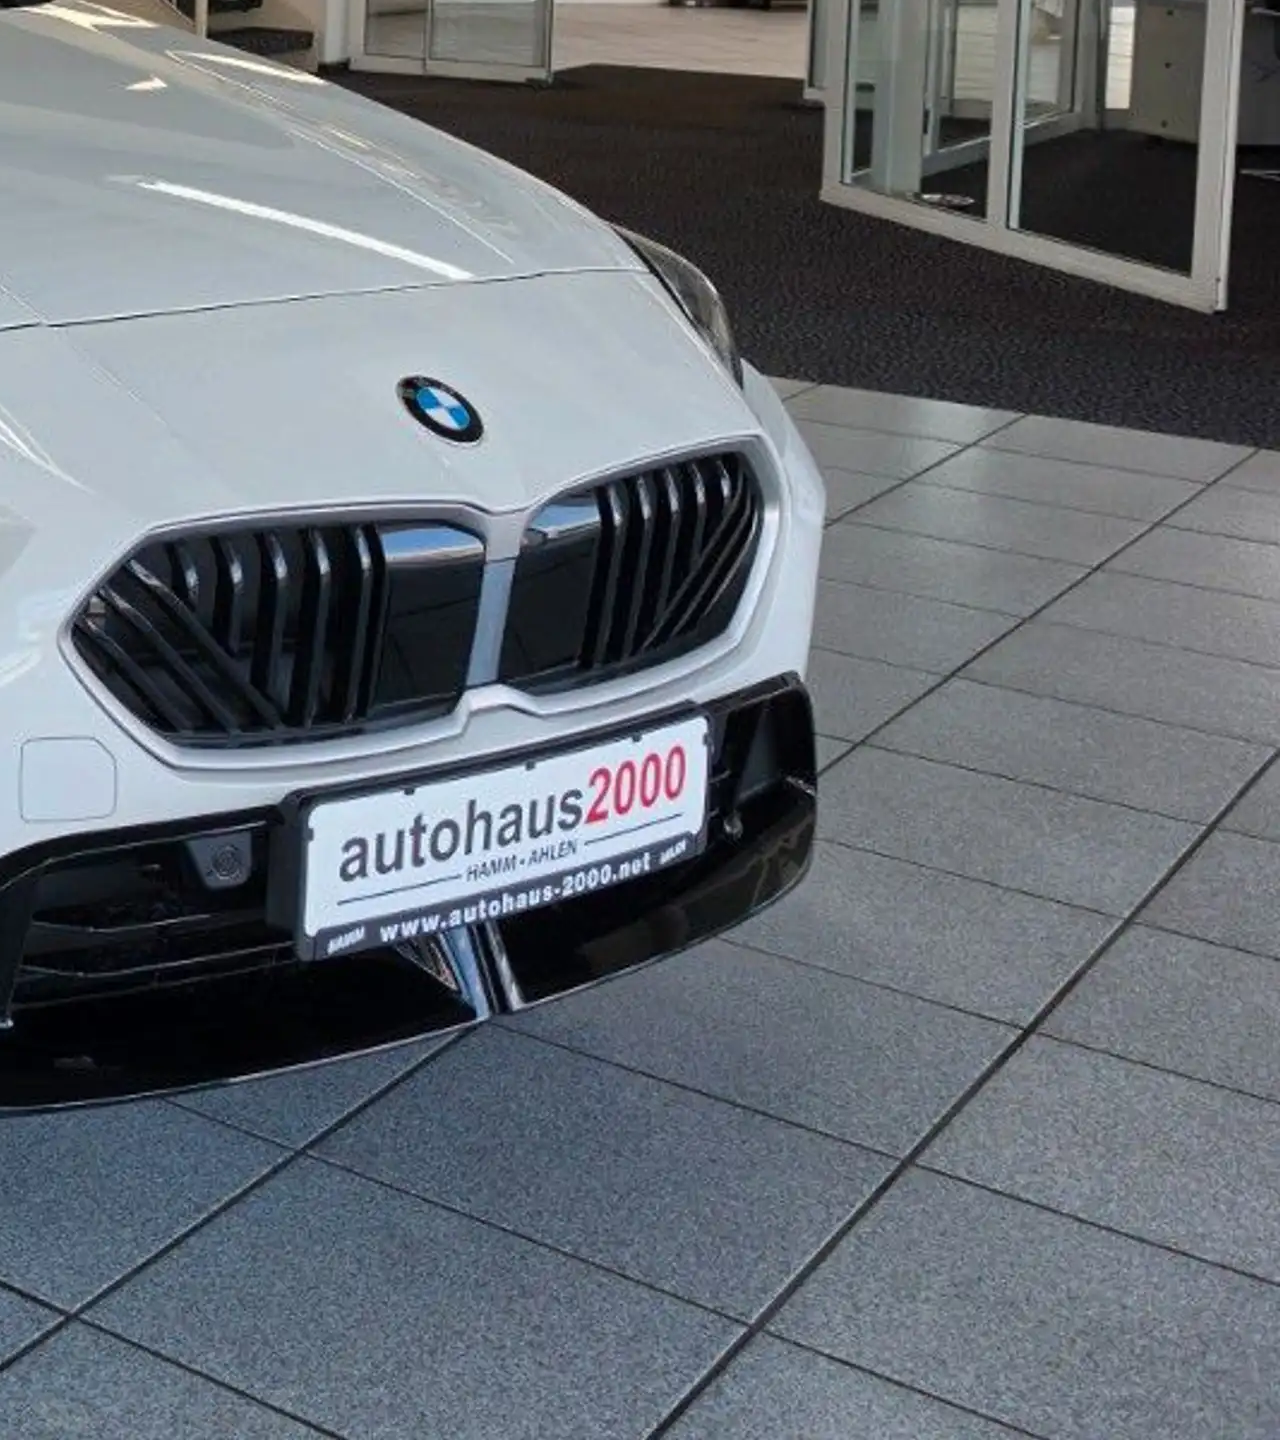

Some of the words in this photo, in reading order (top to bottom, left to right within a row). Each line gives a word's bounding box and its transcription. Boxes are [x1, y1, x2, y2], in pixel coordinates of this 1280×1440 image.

[339, 745, 687, 883] autohaus2000
[380, 852, 651, 943] www.autohaus-2000.net
[465, 853, 518, 882] HAMM
[528, 839, 579, 867] AHLEN
